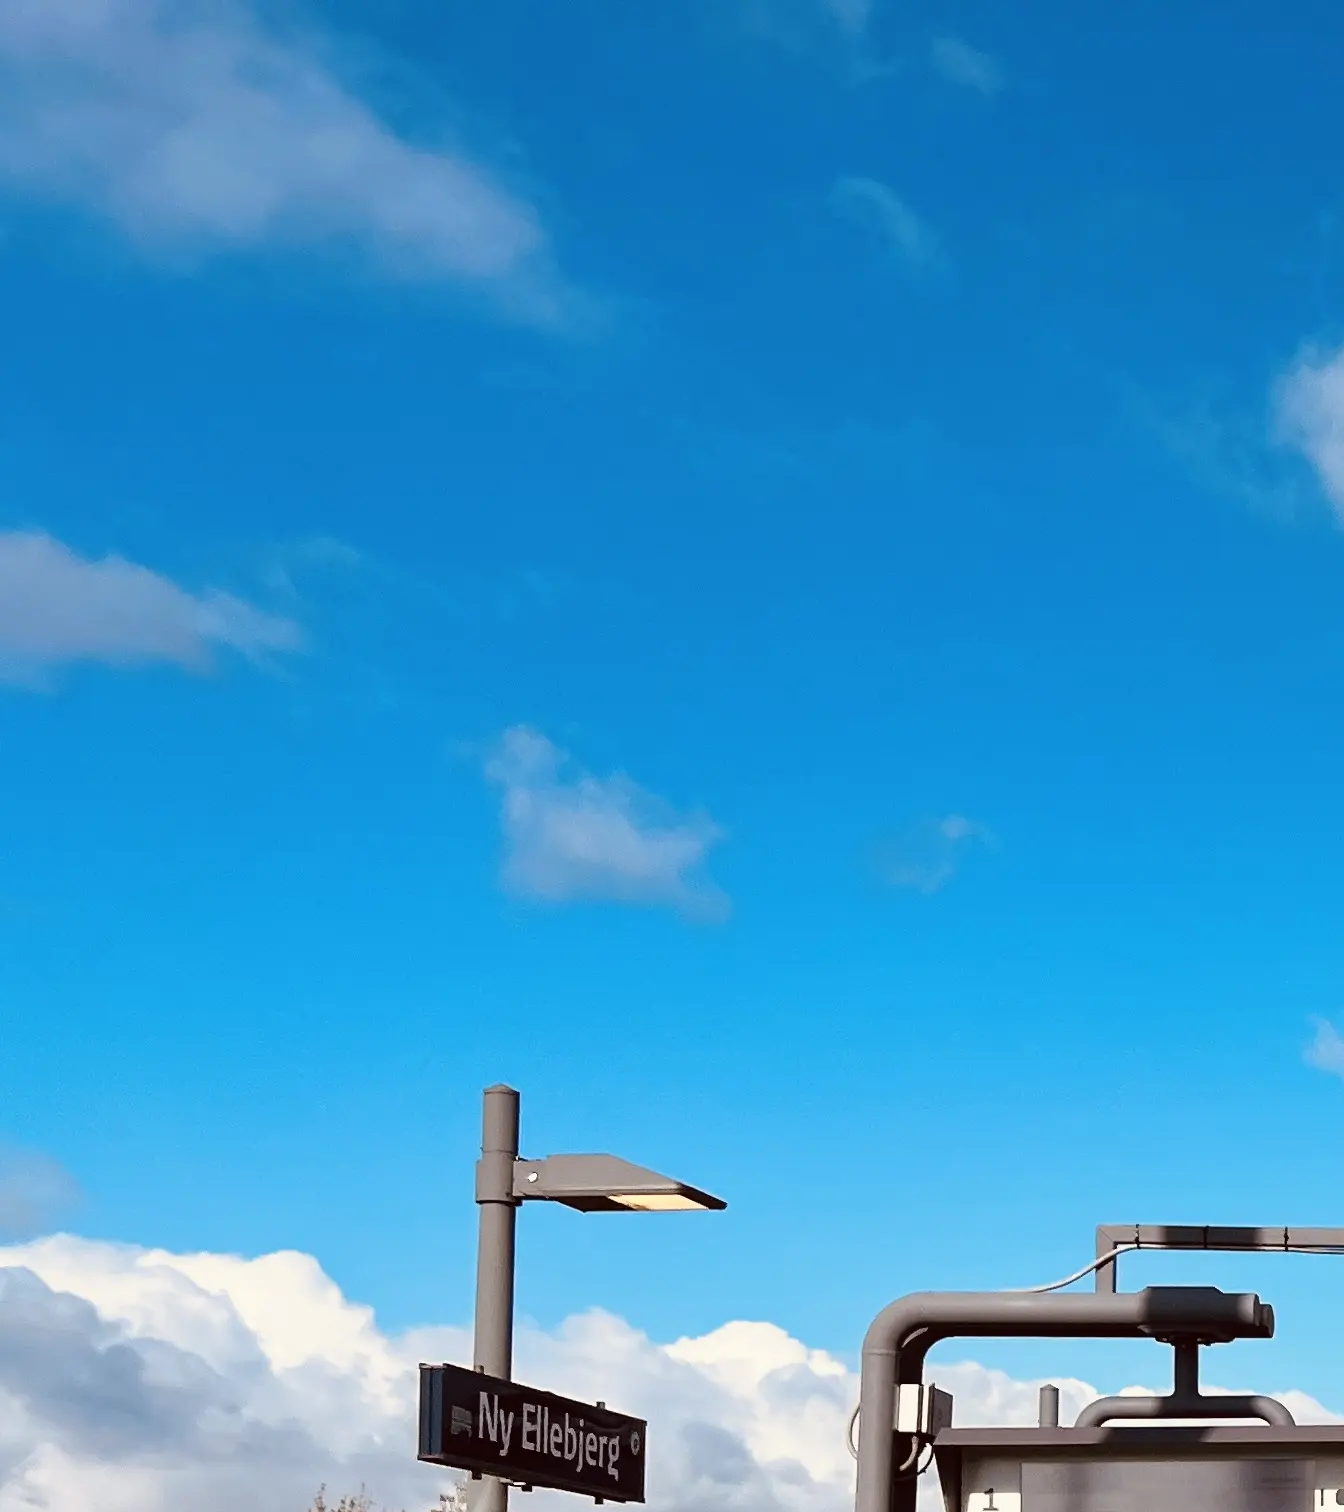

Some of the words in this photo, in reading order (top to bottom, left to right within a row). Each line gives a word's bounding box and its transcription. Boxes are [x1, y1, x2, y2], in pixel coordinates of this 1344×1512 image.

[478, 1391, 514, 1456] Ny
[522, 1403, 620, 1481] Ellebjerg
[983, 1488, 999, 1511] 1
